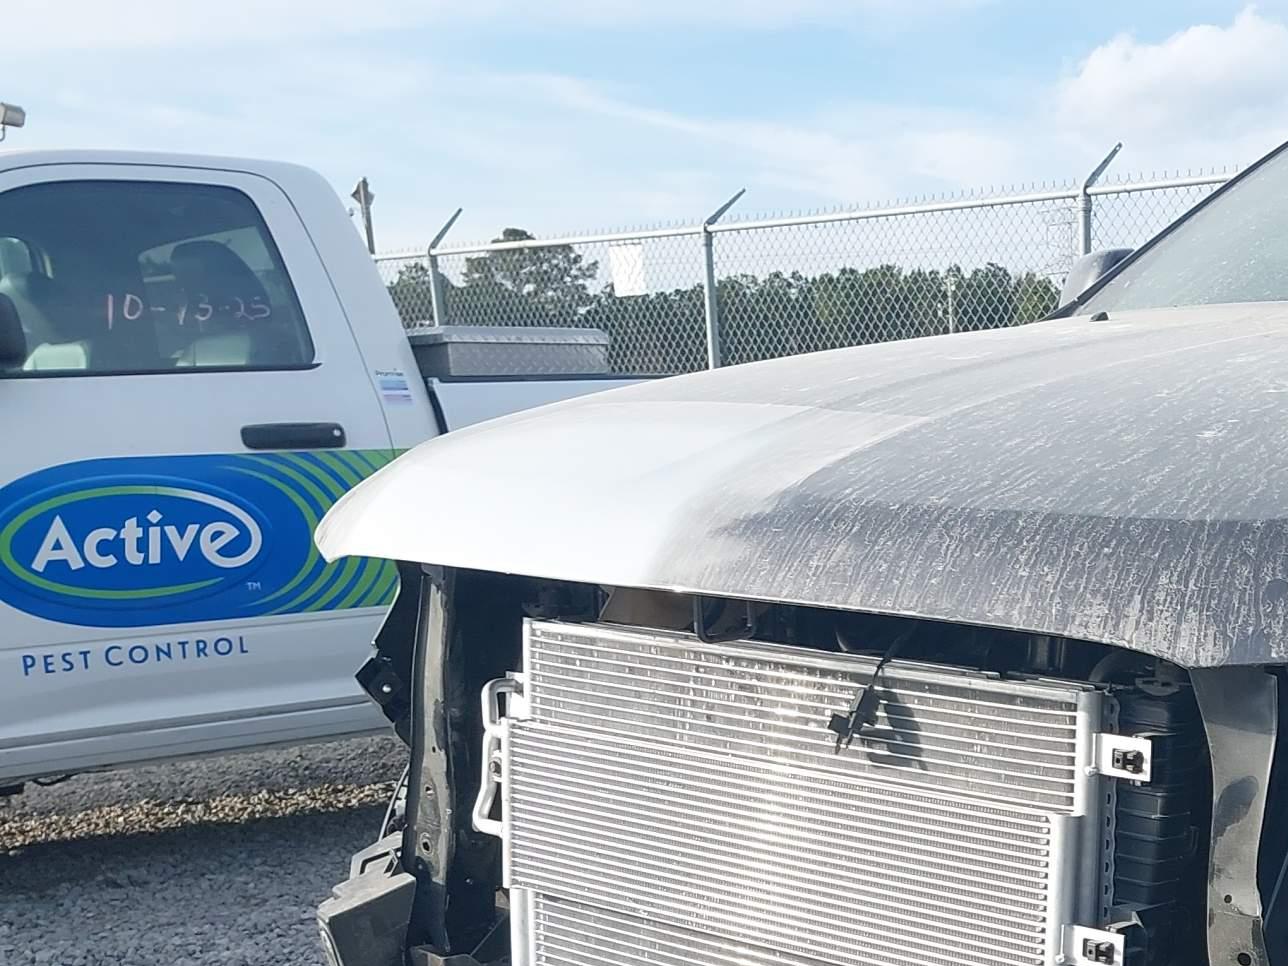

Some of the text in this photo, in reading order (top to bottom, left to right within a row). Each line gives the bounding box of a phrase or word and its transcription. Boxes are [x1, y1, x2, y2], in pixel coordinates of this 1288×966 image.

[31, 509, 263, 573] Active
[22, 637, 249, 676] PEST CONTROL
